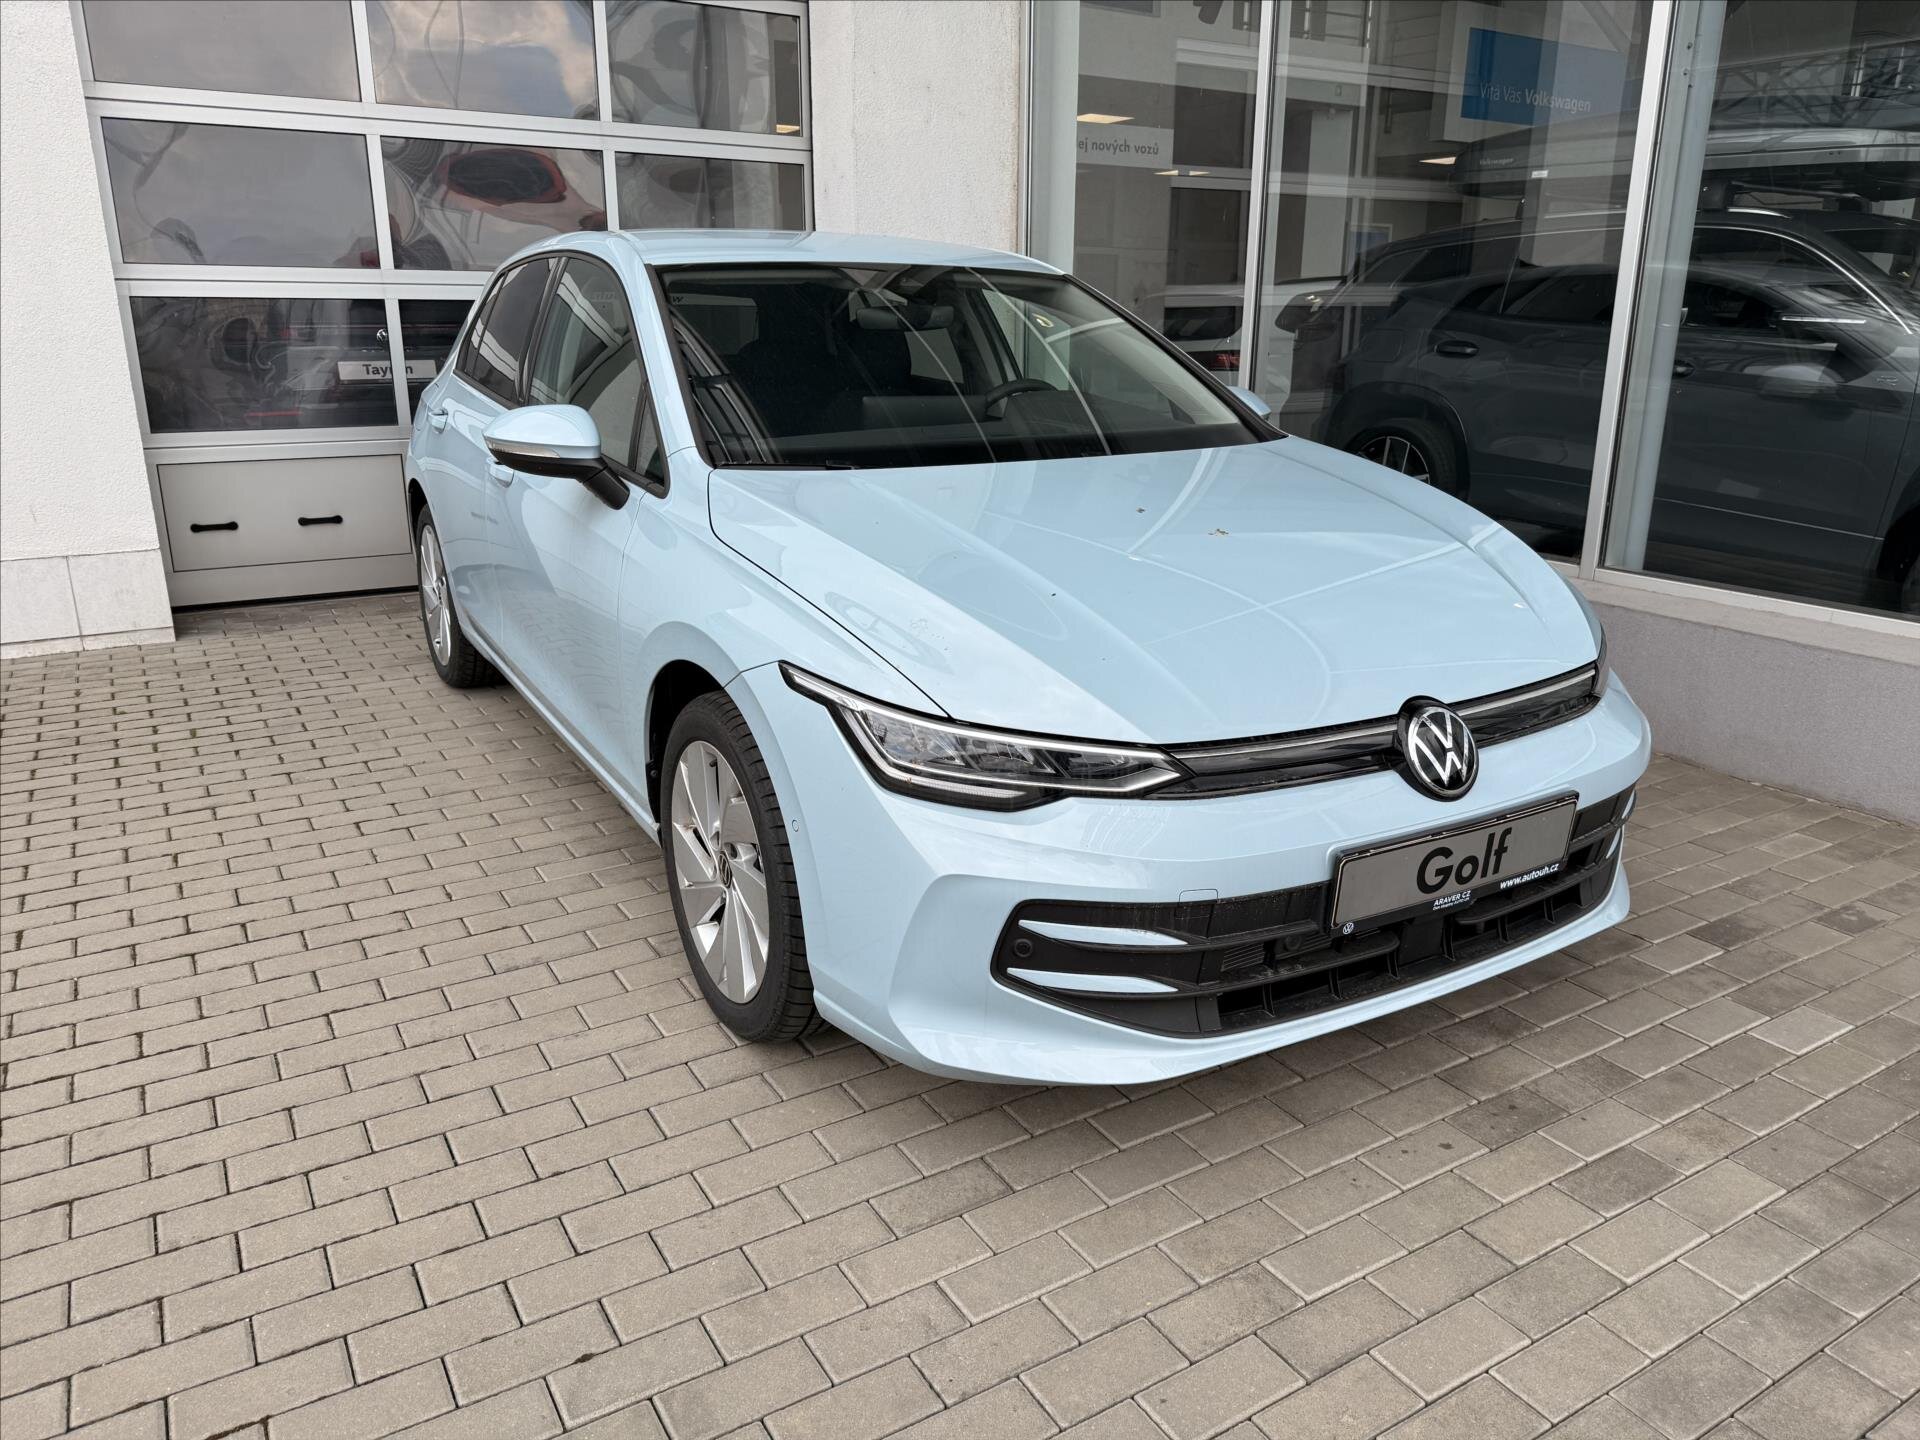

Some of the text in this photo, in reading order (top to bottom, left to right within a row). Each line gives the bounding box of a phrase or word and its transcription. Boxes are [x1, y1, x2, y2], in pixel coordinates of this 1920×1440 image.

[1525, 88, 1592, 114] Volkswagen
[1091, 138, 1131, 156] nových
[1134, 142, 1159, 155] vozů
[361, 363, 414, 378] Tayn
[1416, 826, 1513, 895] Golf
[1500, 863, 1560, 890] www.autouh.cz
[1433, 893, 1461, 907] ARAVER
[1461, 890, 1472, 899] CZ
